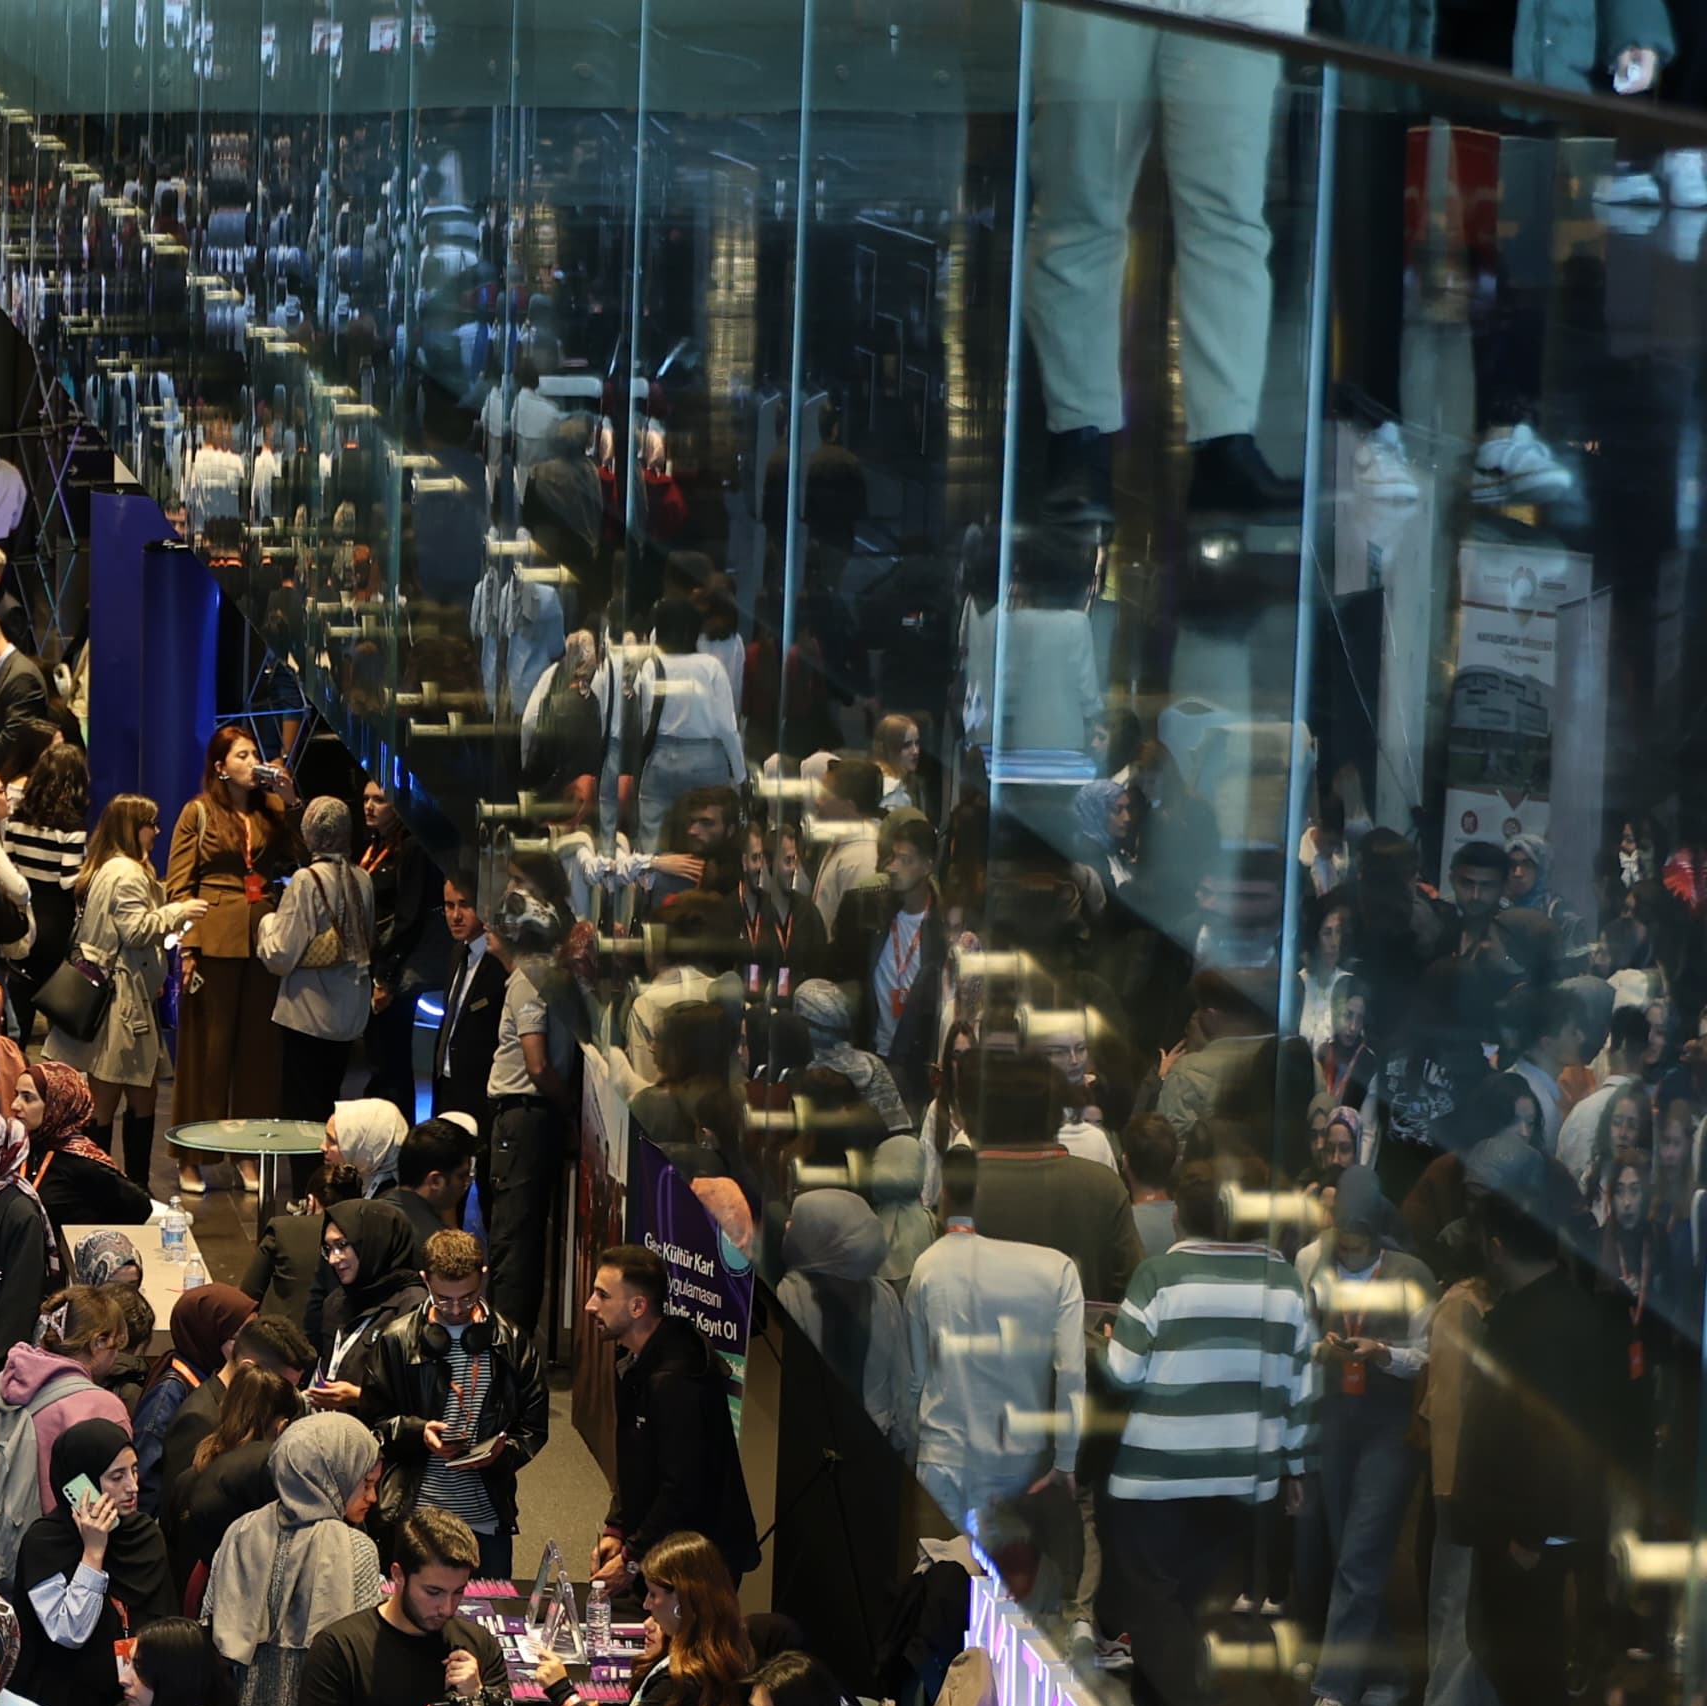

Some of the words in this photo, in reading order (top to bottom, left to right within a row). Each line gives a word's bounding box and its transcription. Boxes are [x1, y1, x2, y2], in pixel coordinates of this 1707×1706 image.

[662, 1241, 693, 1270] Kültür
[694, 1252, 715, 1278] Kart
[667, 1272, 722, 1309] ygulamasını
[696, 1310, 723, 1338] Kayıt
[724, 1321, 737, 1341] Ol
